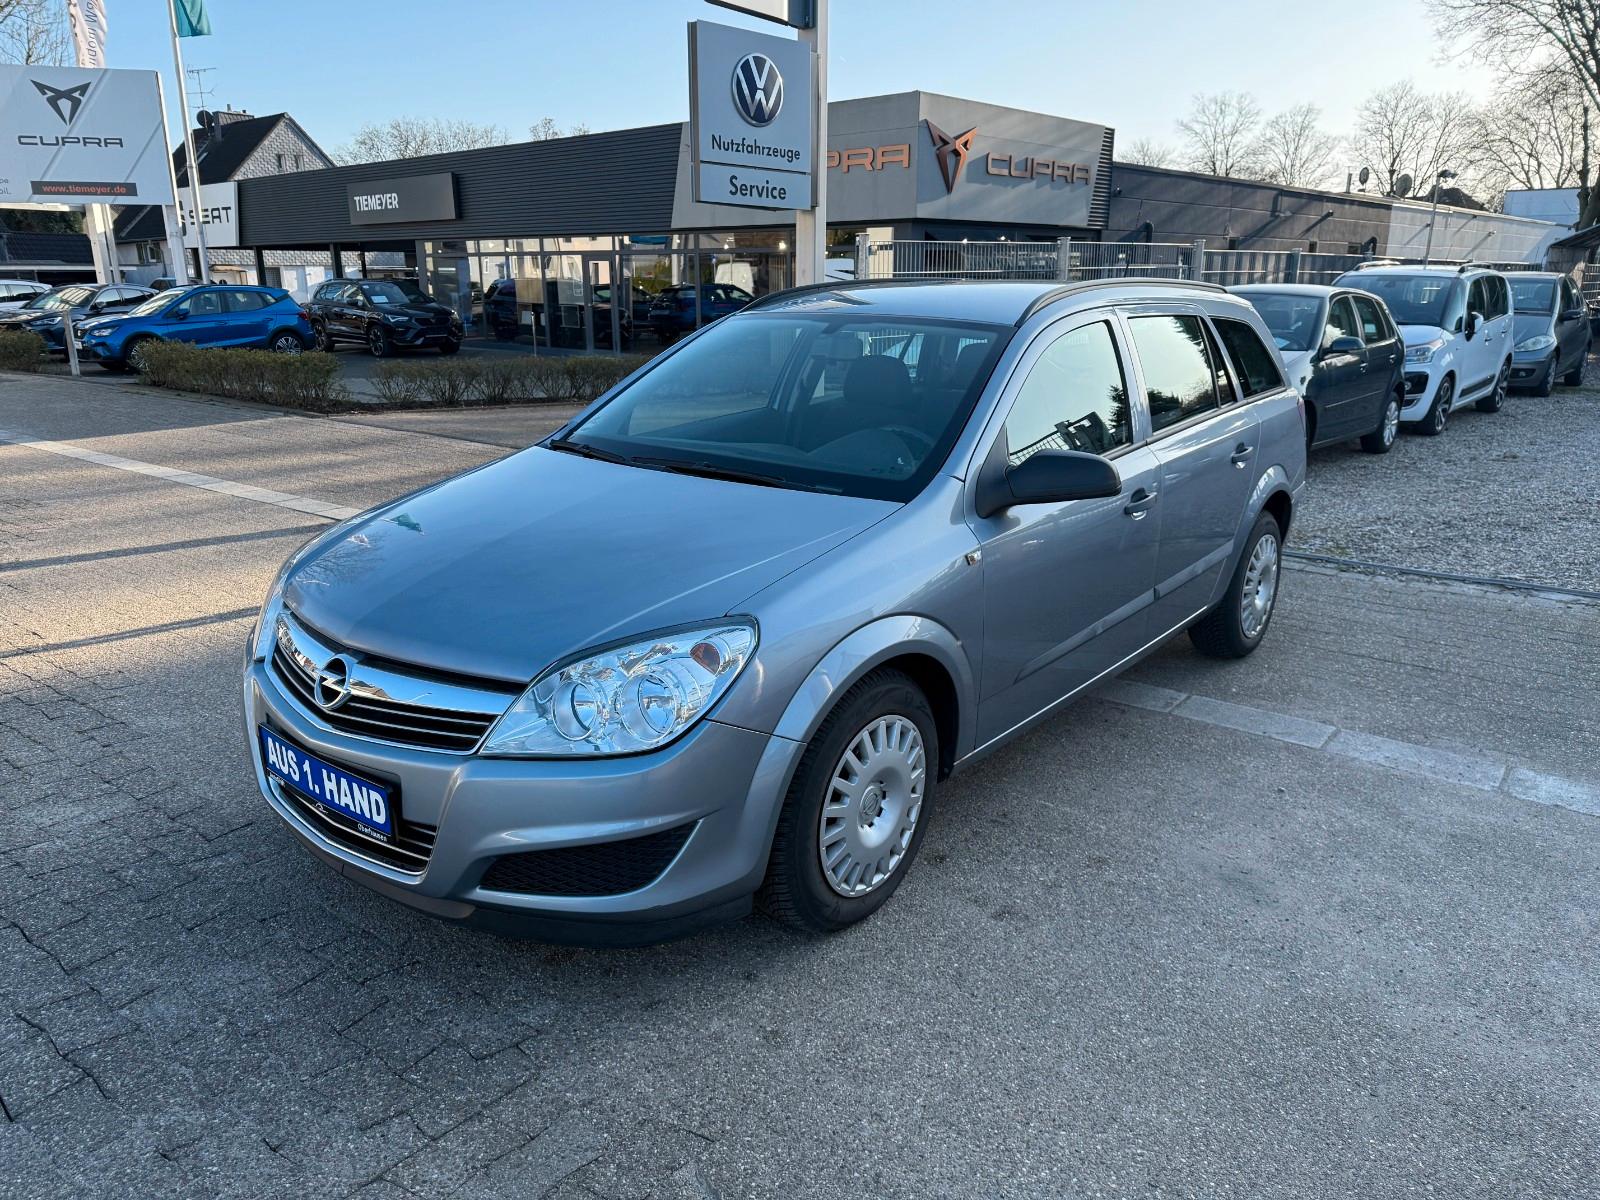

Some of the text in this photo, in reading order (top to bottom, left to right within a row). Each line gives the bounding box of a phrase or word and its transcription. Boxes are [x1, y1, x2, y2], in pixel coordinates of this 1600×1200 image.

[18, 135, 124, 148] CUPRA
[711, 134, 800, 163] Nutzfahrzeuge
[986, 151, 1092, 185] CUPRA
[42, 184, 127, 195] www.tiemeyer.de
[729, 174, 787, 200] Service
[354, 193, 398, 211] TIEMEYER
[266, 736, 386, 824] AUS 1. HAND
